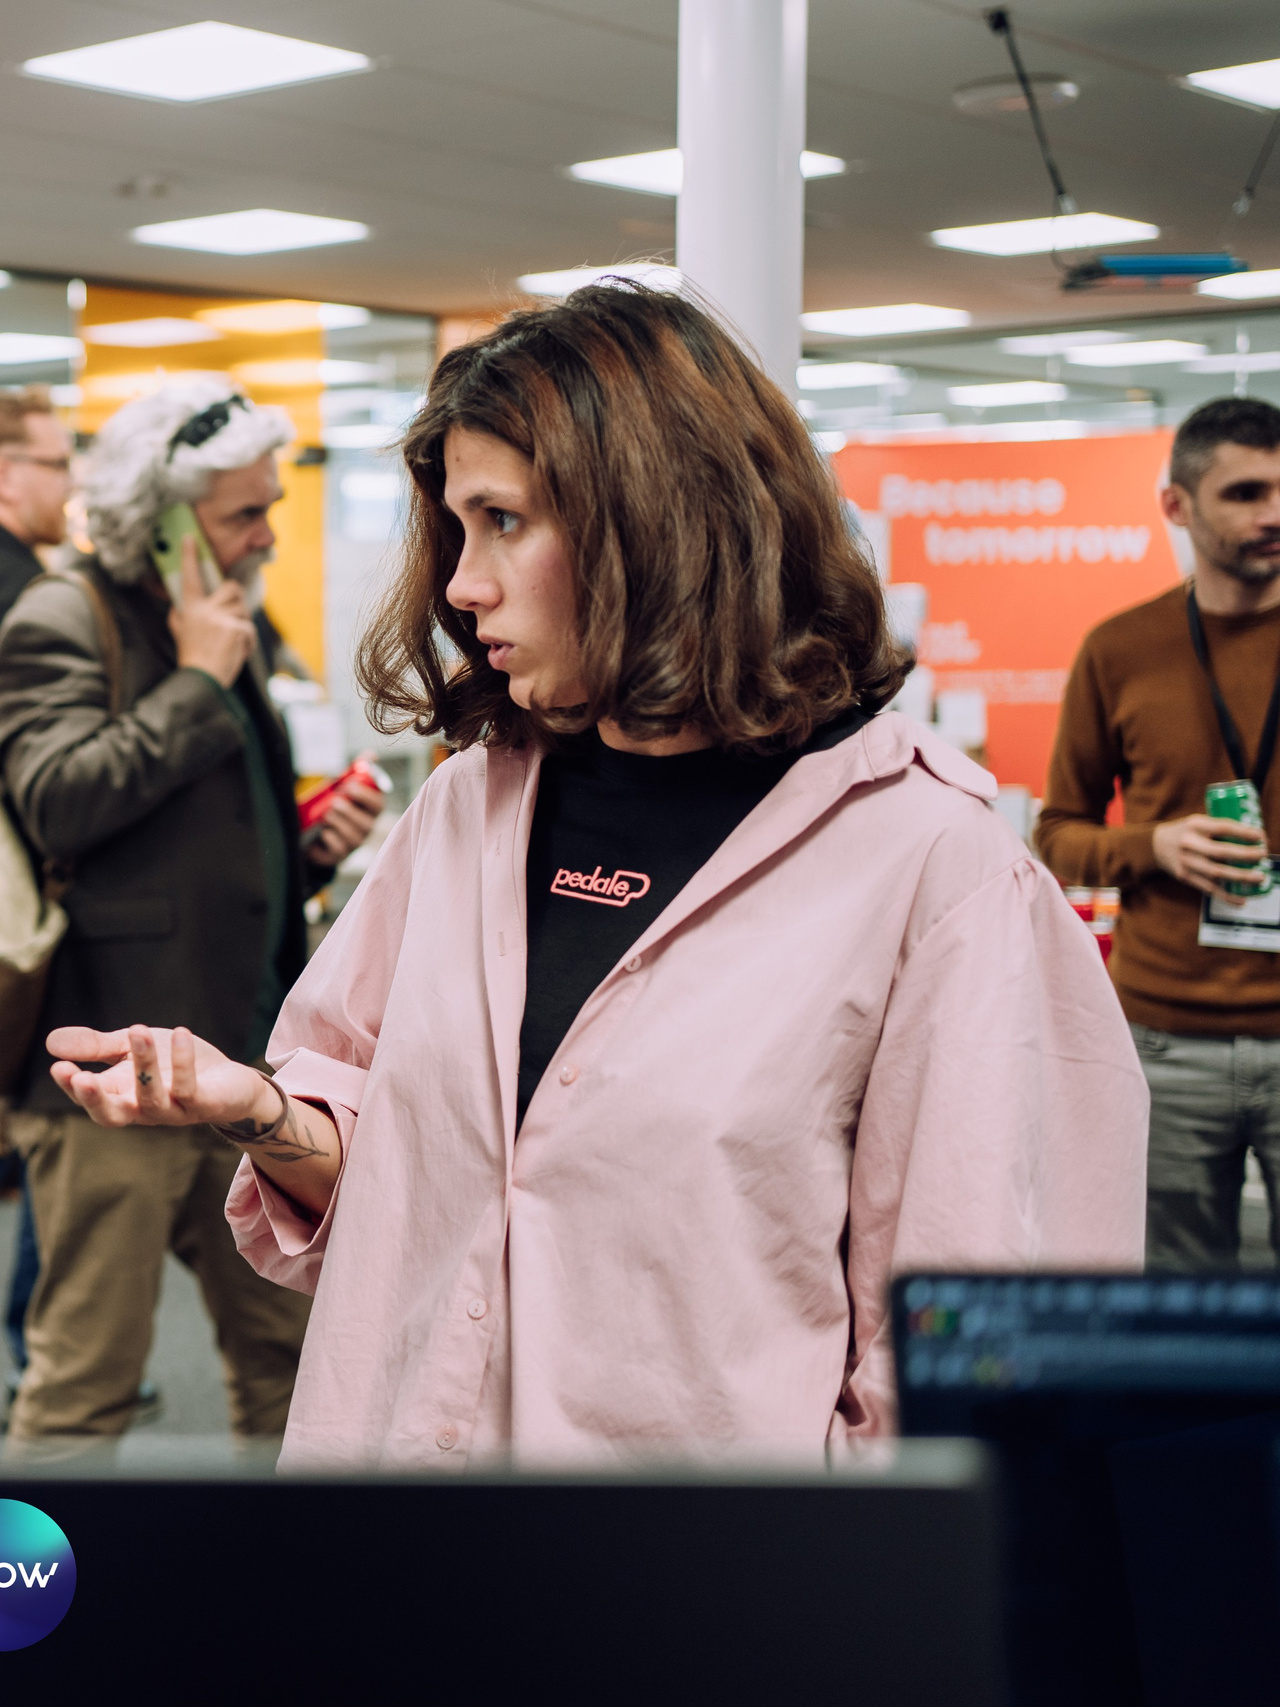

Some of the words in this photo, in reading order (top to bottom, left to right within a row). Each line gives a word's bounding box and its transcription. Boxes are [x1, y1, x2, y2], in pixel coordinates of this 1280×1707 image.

[879, 473, 1066, 518] Because
[924, 520, 1151, 566] tomorrow
[550, 866, 635, 902] pedale
